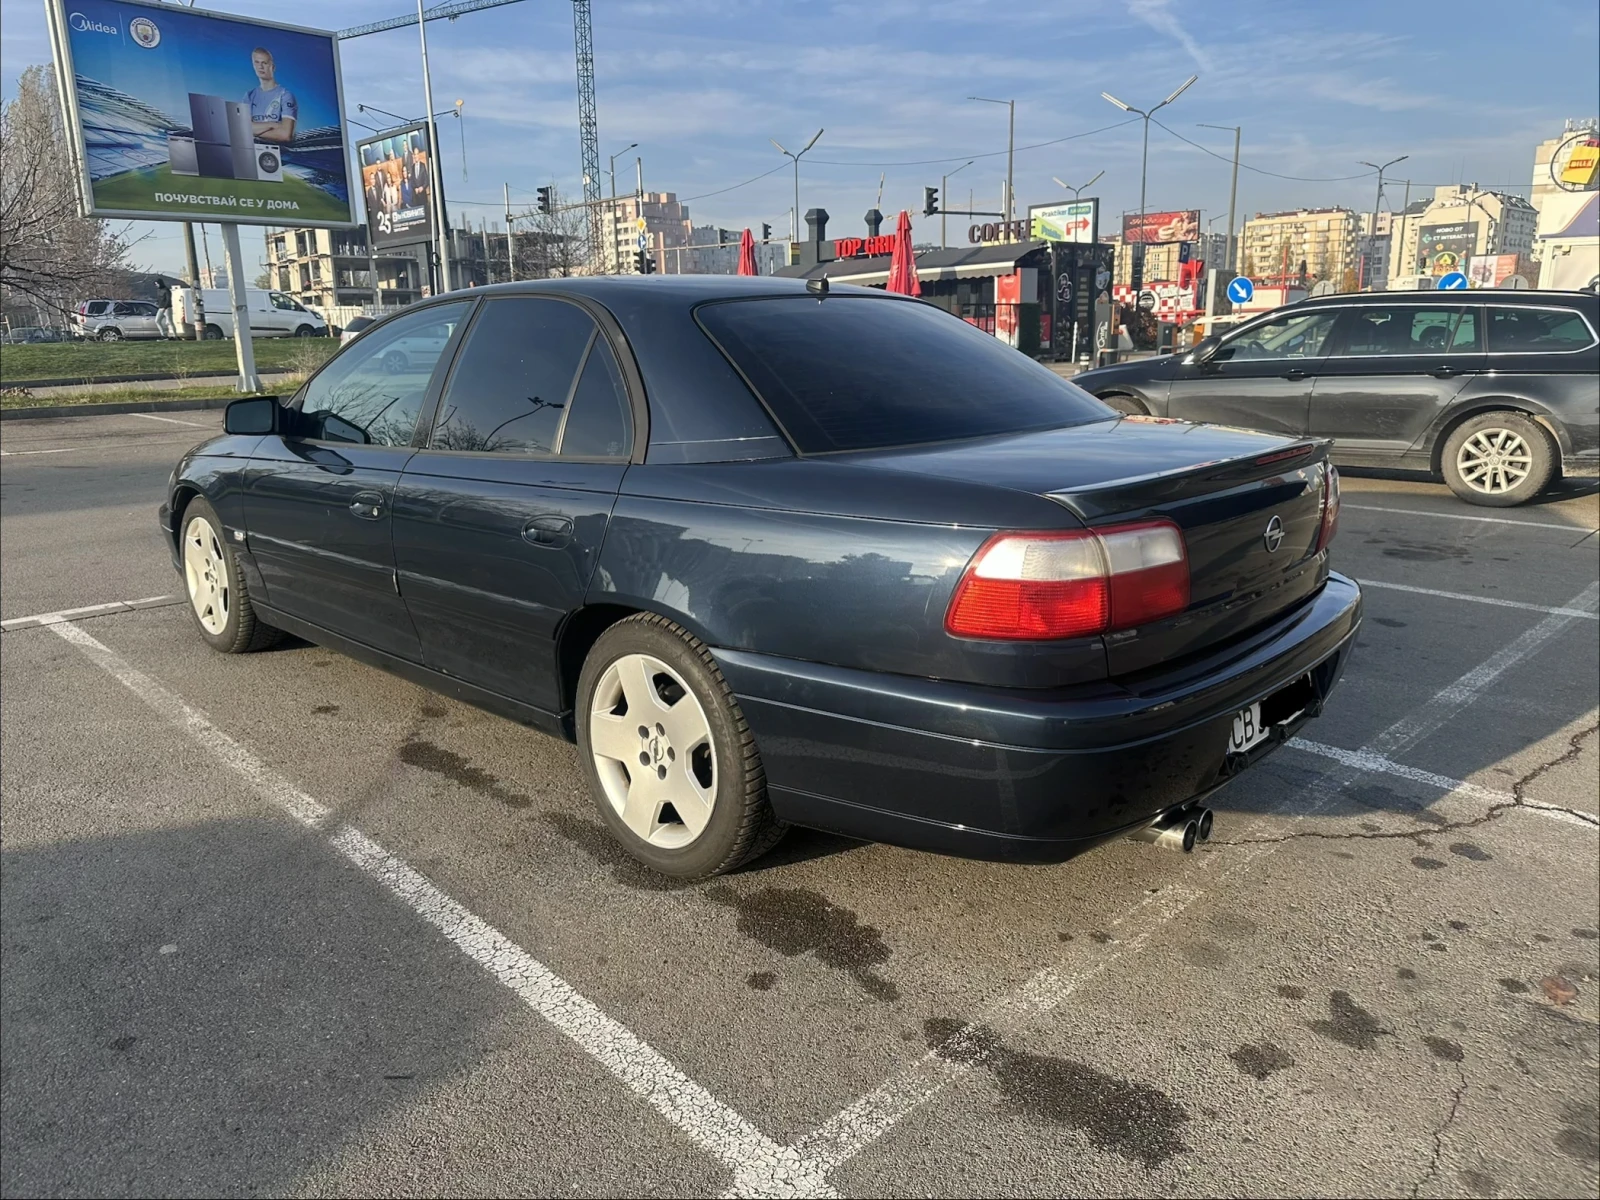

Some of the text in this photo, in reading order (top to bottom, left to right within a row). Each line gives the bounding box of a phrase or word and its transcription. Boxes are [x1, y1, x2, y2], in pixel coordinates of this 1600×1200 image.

[70, 13, 117, 34] Midea
[154, 192, 299, 210] ПОЧУВСТВАЙ СЕ У ДОМА
[377, 211, 391, 234] 25
[1042, 208, 1067, 218] Praktiker
[968, 218, 1037, 244] COFFEE
[834, 238, 861, 258] TOP
